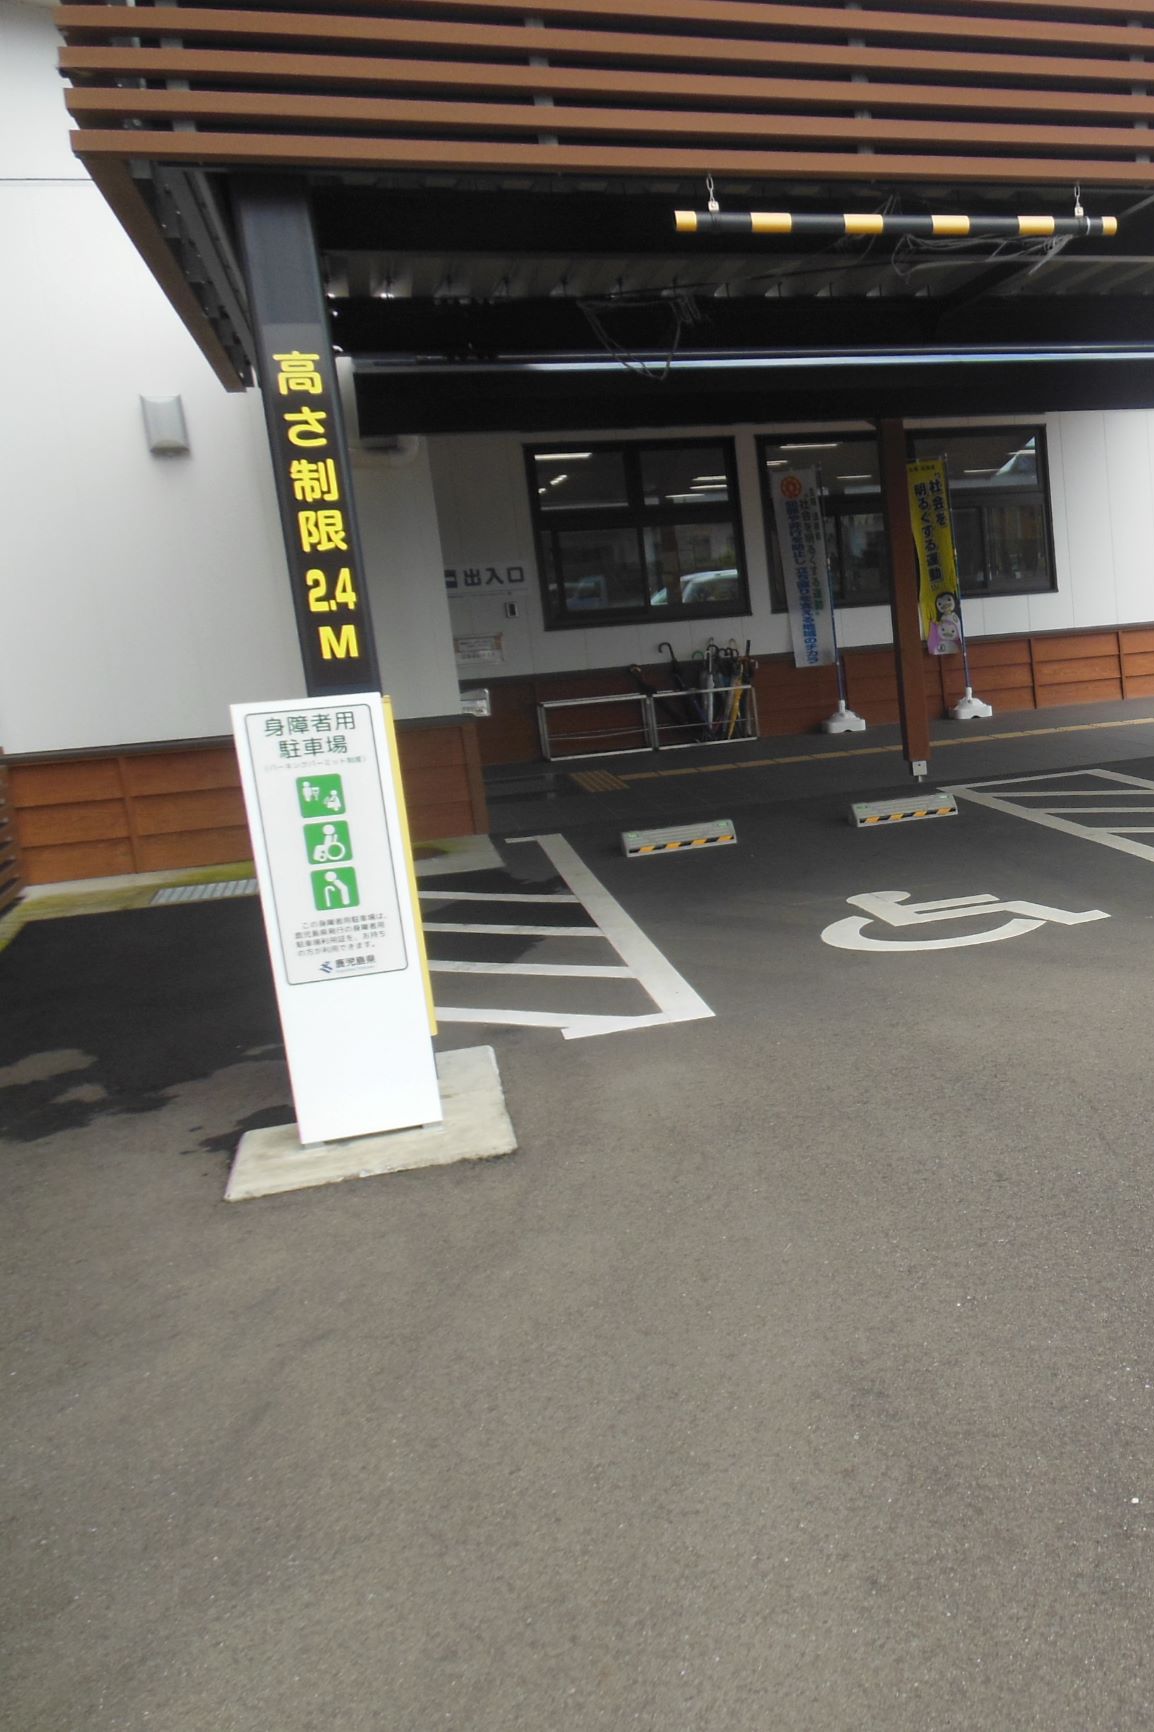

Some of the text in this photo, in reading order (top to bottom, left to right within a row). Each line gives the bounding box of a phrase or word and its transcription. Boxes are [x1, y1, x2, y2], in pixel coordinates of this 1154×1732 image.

[272, 350, 359, 660] 高さ制限2.4M
[264, 711, 356, 737] 身障者用
[279, 735, 348, 759] 駐車場
[335, 954, 375, 969] 鹿児島県
